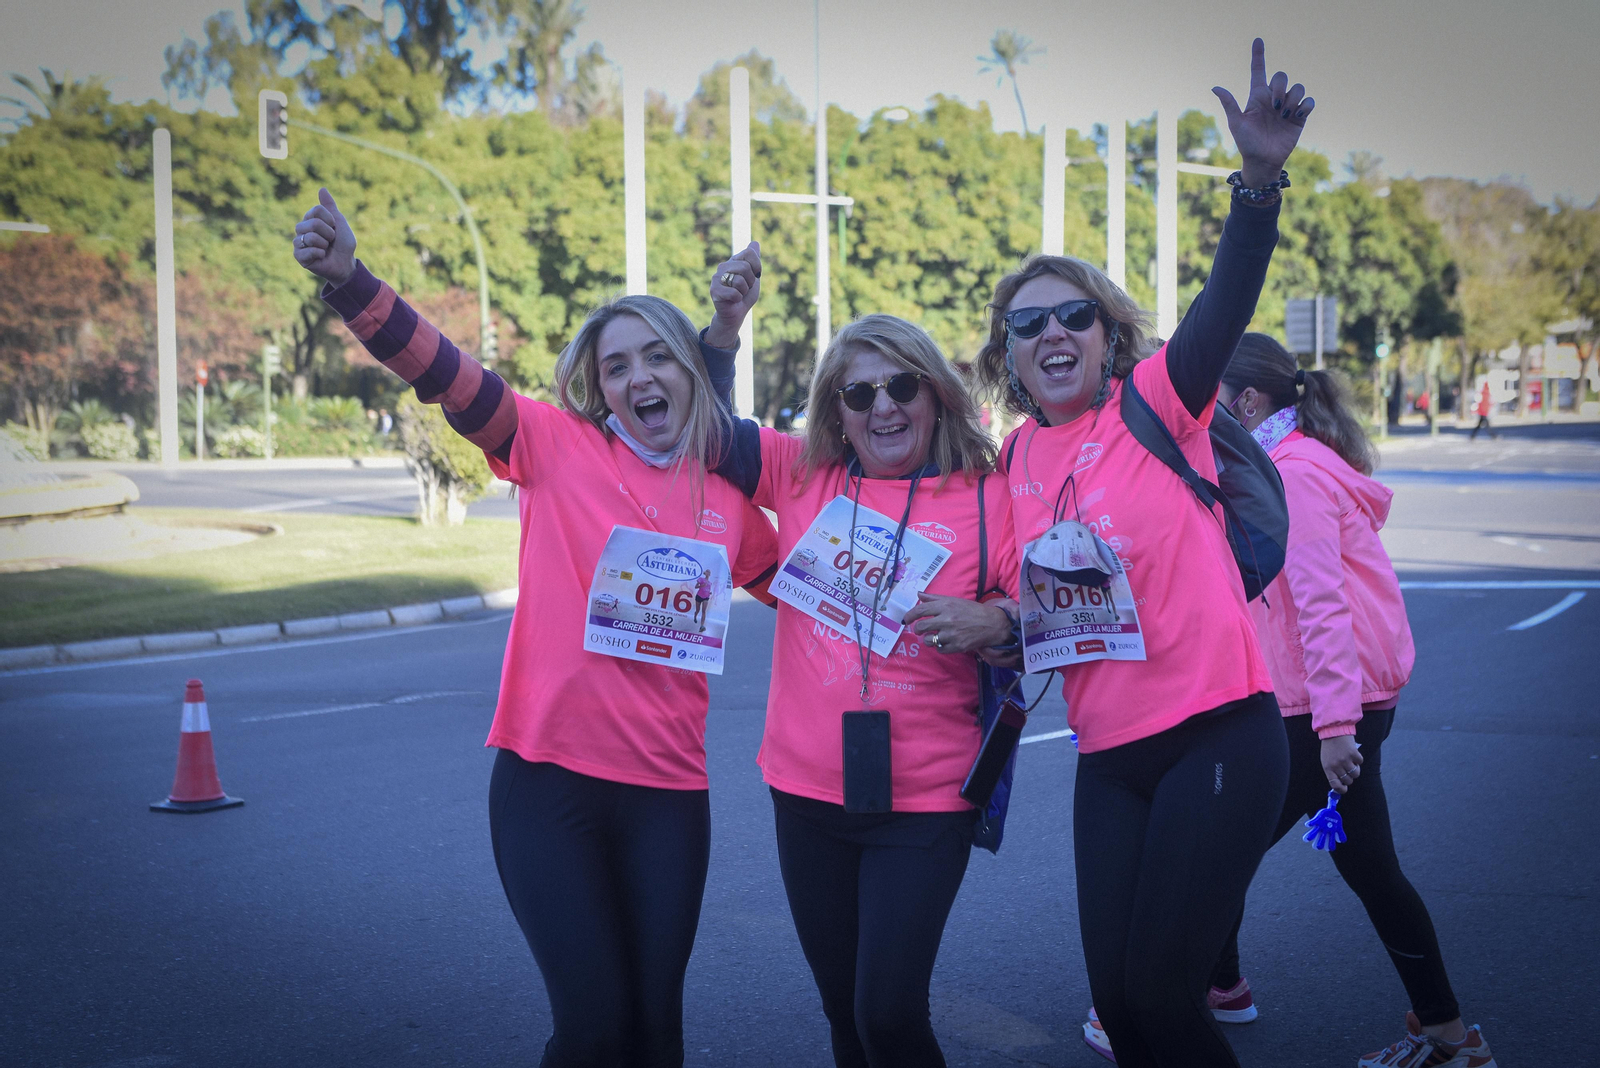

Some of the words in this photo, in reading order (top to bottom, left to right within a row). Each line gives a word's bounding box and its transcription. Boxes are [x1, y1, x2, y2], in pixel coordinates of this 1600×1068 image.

[1011, 481, 1043, 498] SHO
[1088, 514, 1114, 535] OR
[641, 555, 697, 577] ASTURIANA
[833, 550, 886, 588] 016
[777, 579, 816, 606] OYSHO
[833, 577, 860, 597] 3530
[635, 583, 694, 613] 016
[804, 574, 836, 597] CARRERA
[835, 592, 847, 602] DE
[856, 603, 882, 621] MUJR
[1056, 584, 1103, 609] 016
[1134, 597, 1147, 607] 021
[643, 612, 674, 628] 3532
[826, 608, 846, 621] Santander
[1072, 612, 1096, 624] 3531
[590, 632, 631, 650] OYSHO
[612, 620, 648, 634] CARRERA
[649, 627, 662, 636] DE
[662, 629, 674, 639] LA
[675, 631, 704, 644] MUJER
[1044, 626, 1082, 640] CARRERA
[1083, 625, 1093, 633] DE
[1093, 625, 1100, 633] LA
[1101, 625, 1122, 633] MUJER
[645, 645, 668, 654] Santander
[689, 653, 716, 663] ZURICH
[1029, 645, 1070, 664] OYSHO
[897, 682, 916, 691] 2021
